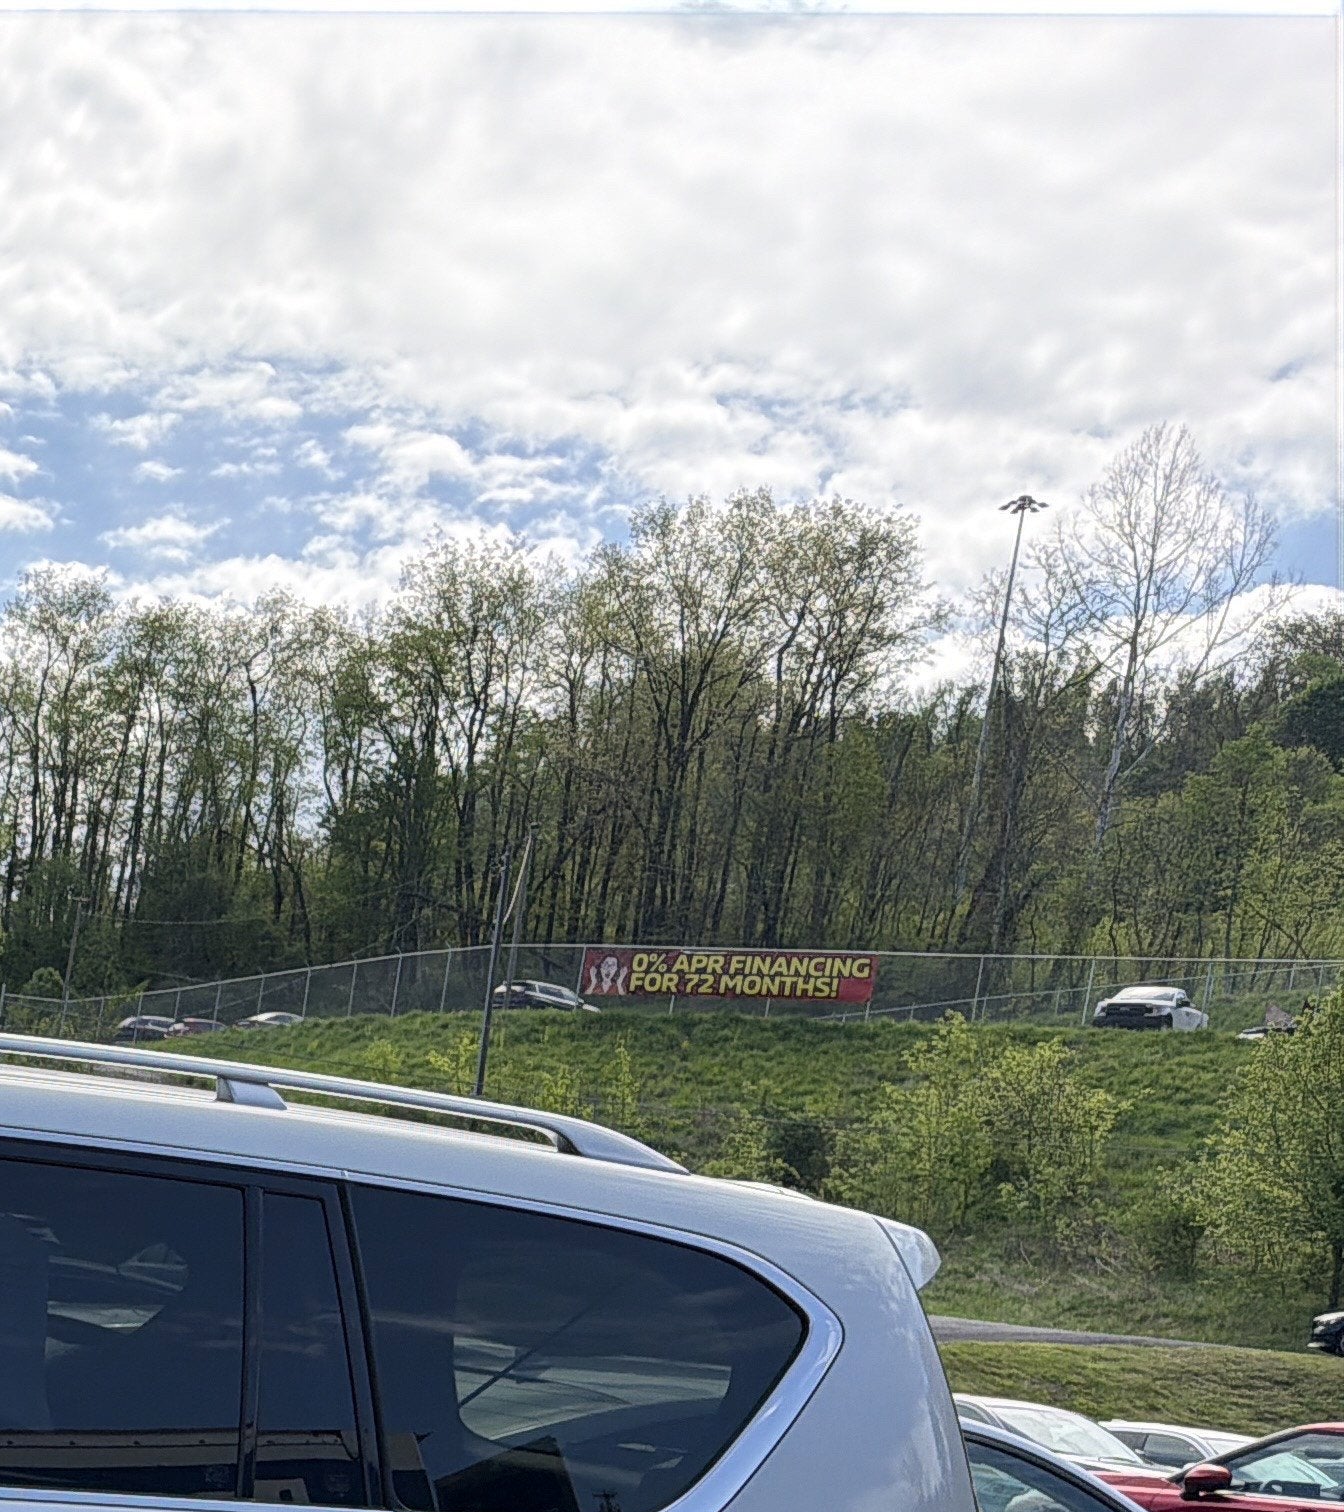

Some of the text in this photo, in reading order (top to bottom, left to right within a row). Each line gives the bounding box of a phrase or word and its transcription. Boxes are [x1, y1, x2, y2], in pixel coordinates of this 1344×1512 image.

[631, 952, 871, 979] 0% APR FINANCING
[628, 972, 840, 998] FOR 72 MONTHS!
